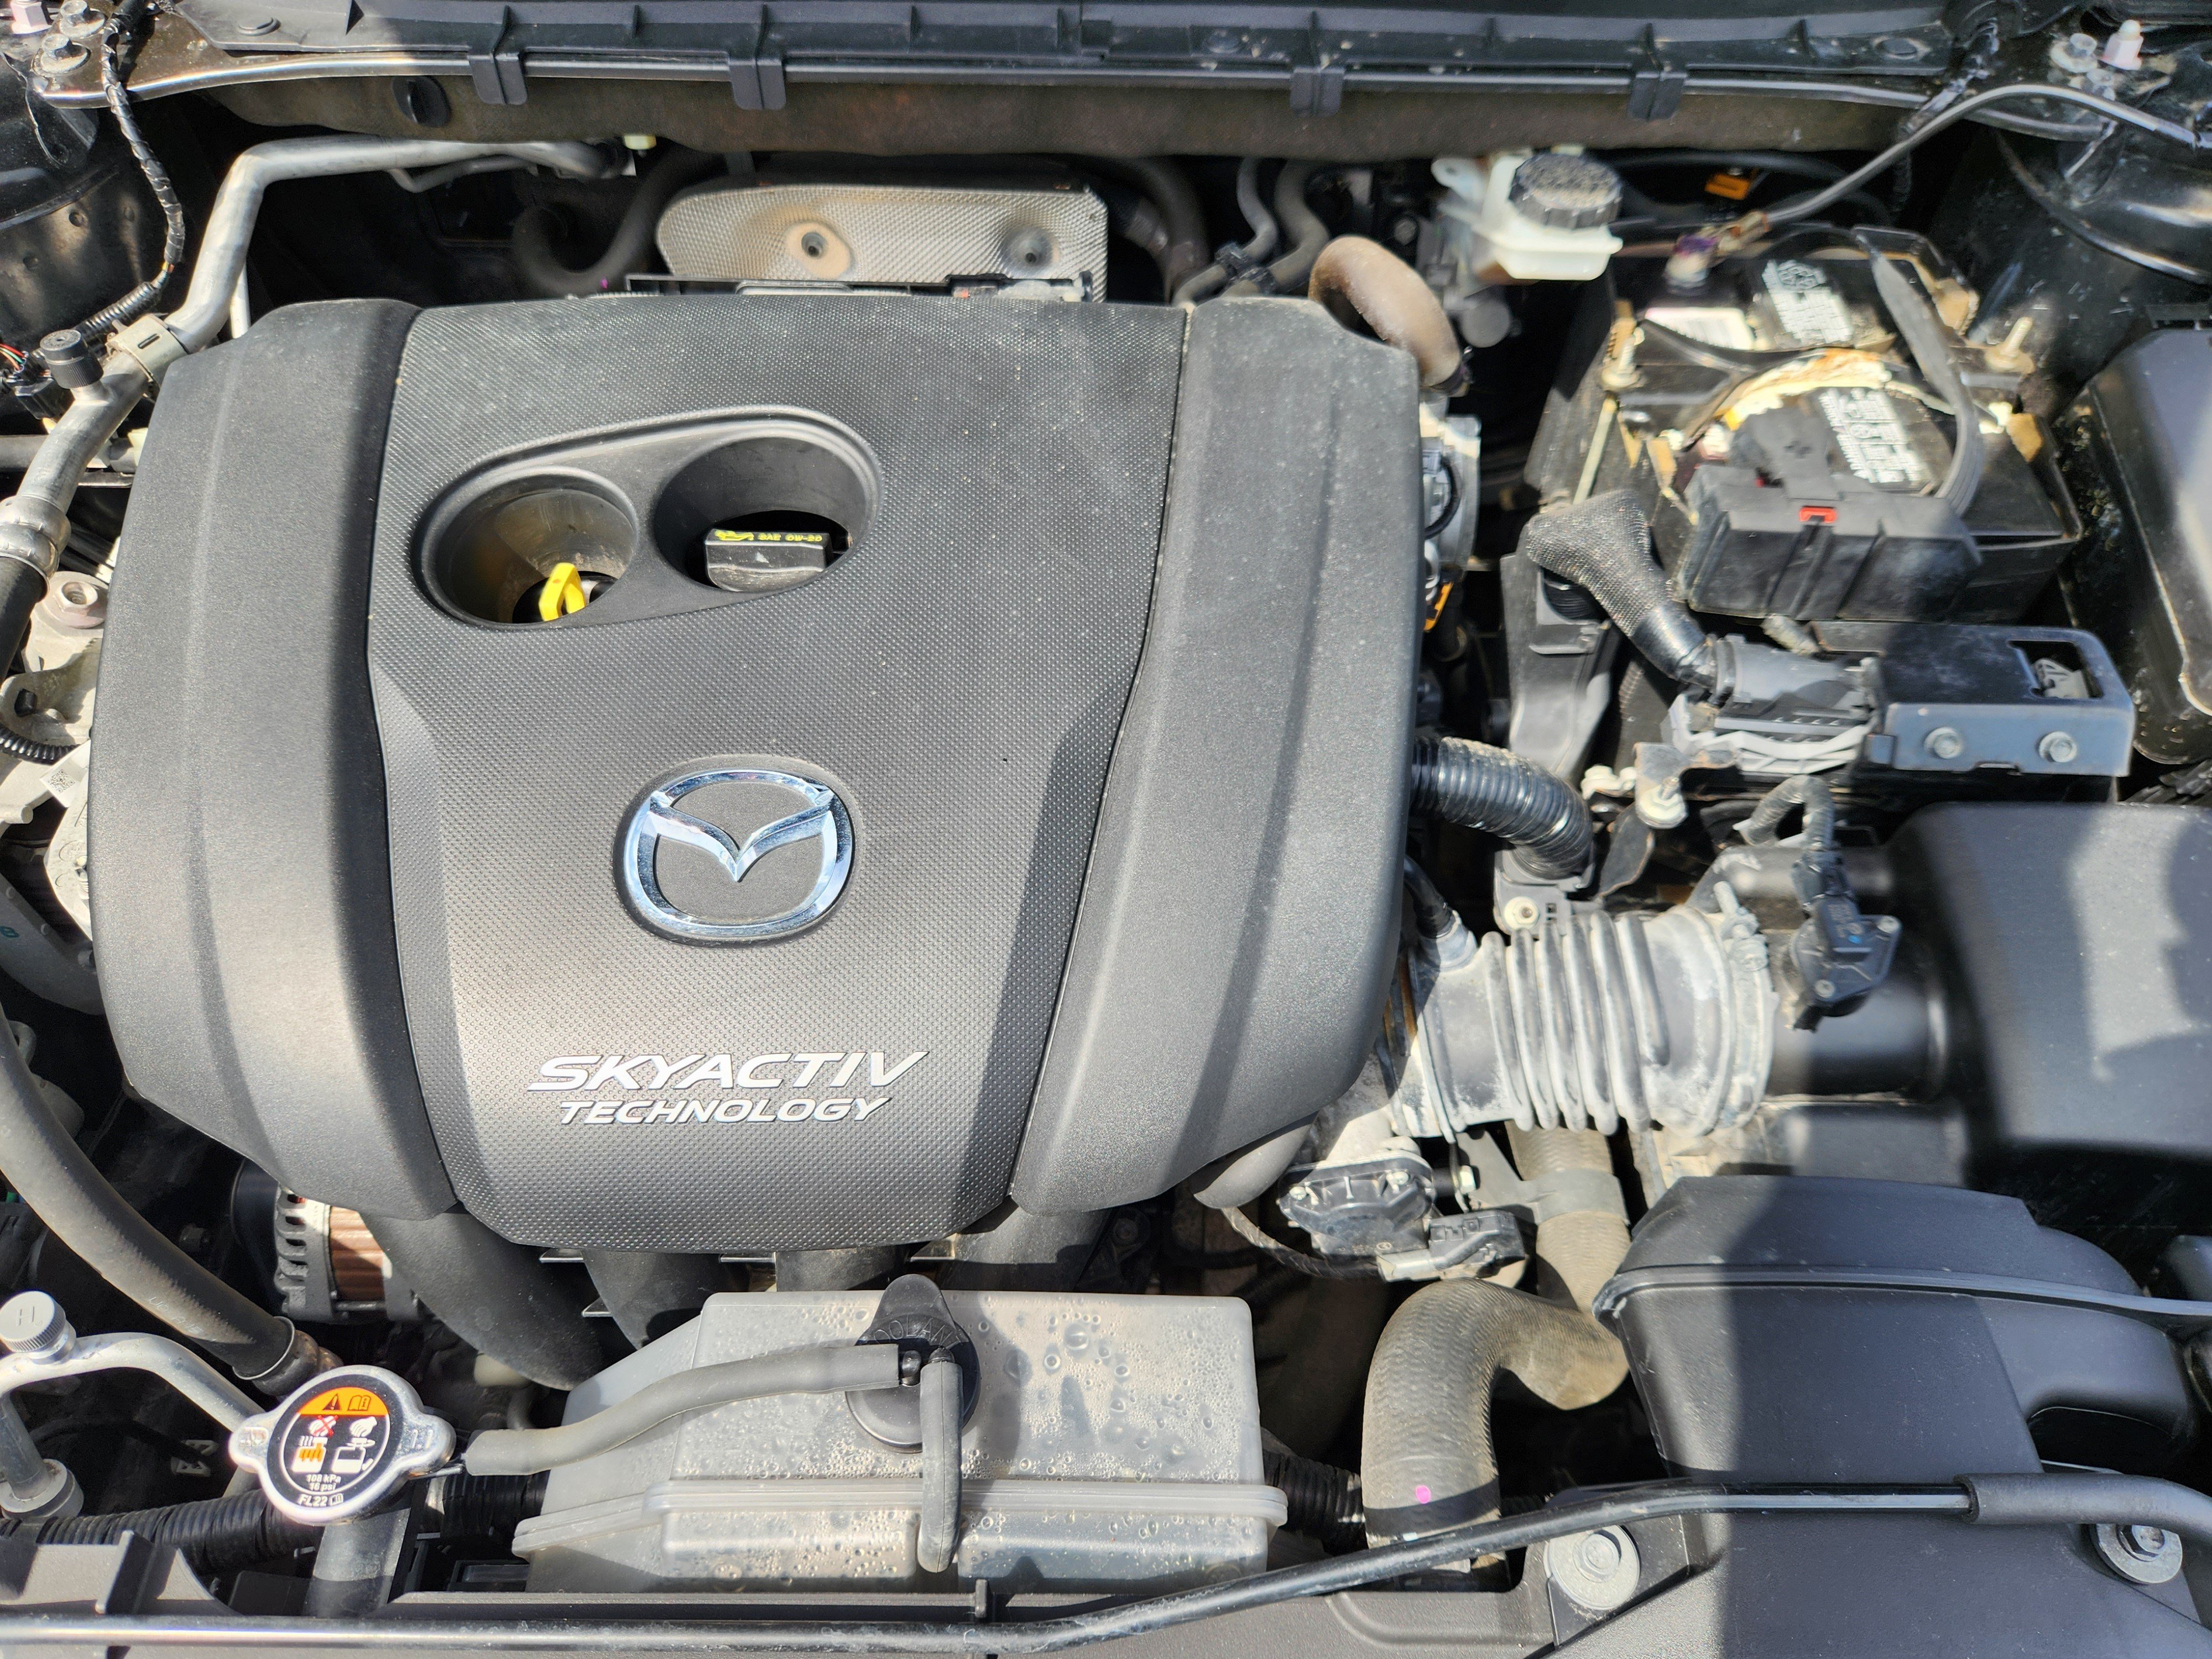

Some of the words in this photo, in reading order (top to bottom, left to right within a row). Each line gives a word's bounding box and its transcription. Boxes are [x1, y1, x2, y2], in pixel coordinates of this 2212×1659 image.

[758, 533, 781, 541] SAE
[527, 1051, 930, 1092] SKYACTIV
[561, 1097, 893, 1125] TECHNOLOGY
[873, 1316, 962, 1350] OOLANT
[306, 1474, 322, 1483] 108
[323, 1474, 341, 1484] kPa
[309, 1483, 321, 1491] 16
[320, 1483, 337, 1492] psi
[297, 1493, 328, 1507] FL22
